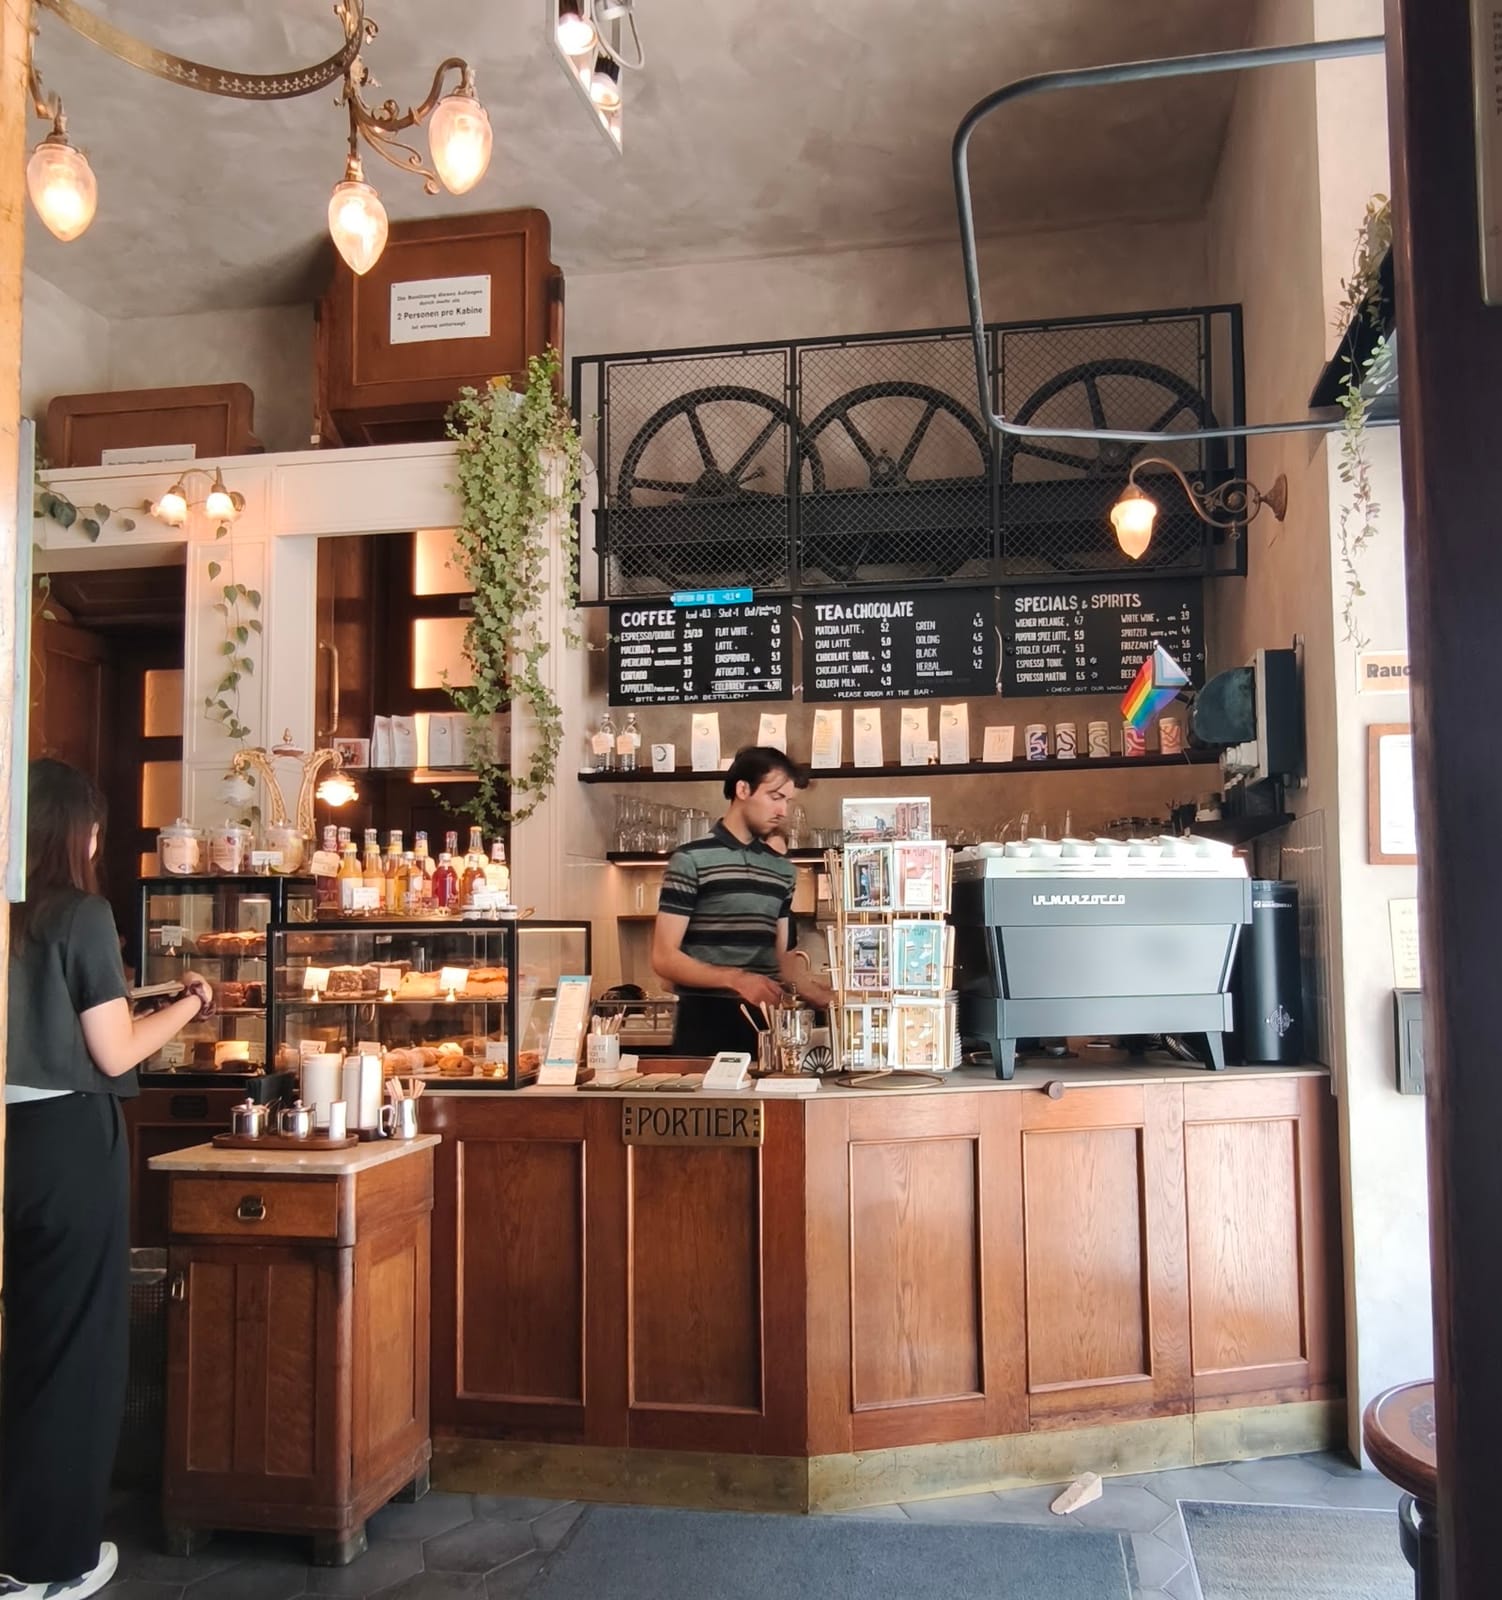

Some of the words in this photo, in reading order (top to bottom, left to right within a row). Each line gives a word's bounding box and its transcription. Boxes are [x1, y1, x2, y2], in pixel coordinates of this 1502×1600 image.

[404, 311, 439, 320] Personen
[441, 310, 454, 318] pro
[456, 306, 483, 316] Kabine
[1015, 596, 1078, 612] SPECIALS
[1082, 600, 1088, 609] &
[1092, 594, 1142, 608] SPIRITS
[719, 608, 732, 618] Shot
[815, 604, 844, 621] TEA
[846, 608, 852, 618] &
[854, 601, 914, 618] CHOCOLATE
[621, 610, 676, 627] COFFEE
[1015, 618, 1036, 628] WIENER
[1038, 617, 1065, 626] MELANGE
[1121, 614, 1138, 622] WHITE
[1140, 614, 1154, 622] WINE
[715, 627, 728, 636] FLAT
[730, 626, 748, 636] WHITE
[816, 625, 840, 635] MATCHA
[841, 624, 860, 634] LATTE
[916, 621, 936, 631] GREEN
[1038, 632, 1050, 640] SPICE
[1052, 631, 1068, 640] LATTE
[1121, 628, 1147, 637] SPRITZER
[816, 640, 830, 649] CHAI
[832, 639, 851, 648] LATTE
[916, 635, 940, 644] OOLONG
[715, 641, 732, 650] LATTE
[816, 652, 850, 662] CHOCOLATE
[916, 648, 937, 658] BLACK
[1016, 659, 1044, 668] ESPRESSO
[1046, 658, 1063, 667] TONIC
[1121, 656, 1144, 664] APEROL
[816, 665, 849, 675] CHOCOLATE
[852, 664, 869, 674] WHITE
[916, 662, 940, 671] HERBAL
[1016, 673, 1043, 682] ESPRESSO
[1044, 672, 1066, 681] MARTINI
[1121, 670, 1136, 678] BEER
[816, 679, 840, 688] GOLDEN
[841, 678, 856, 688] MILK
[637, 1107, 749, 1137] PORTIER
